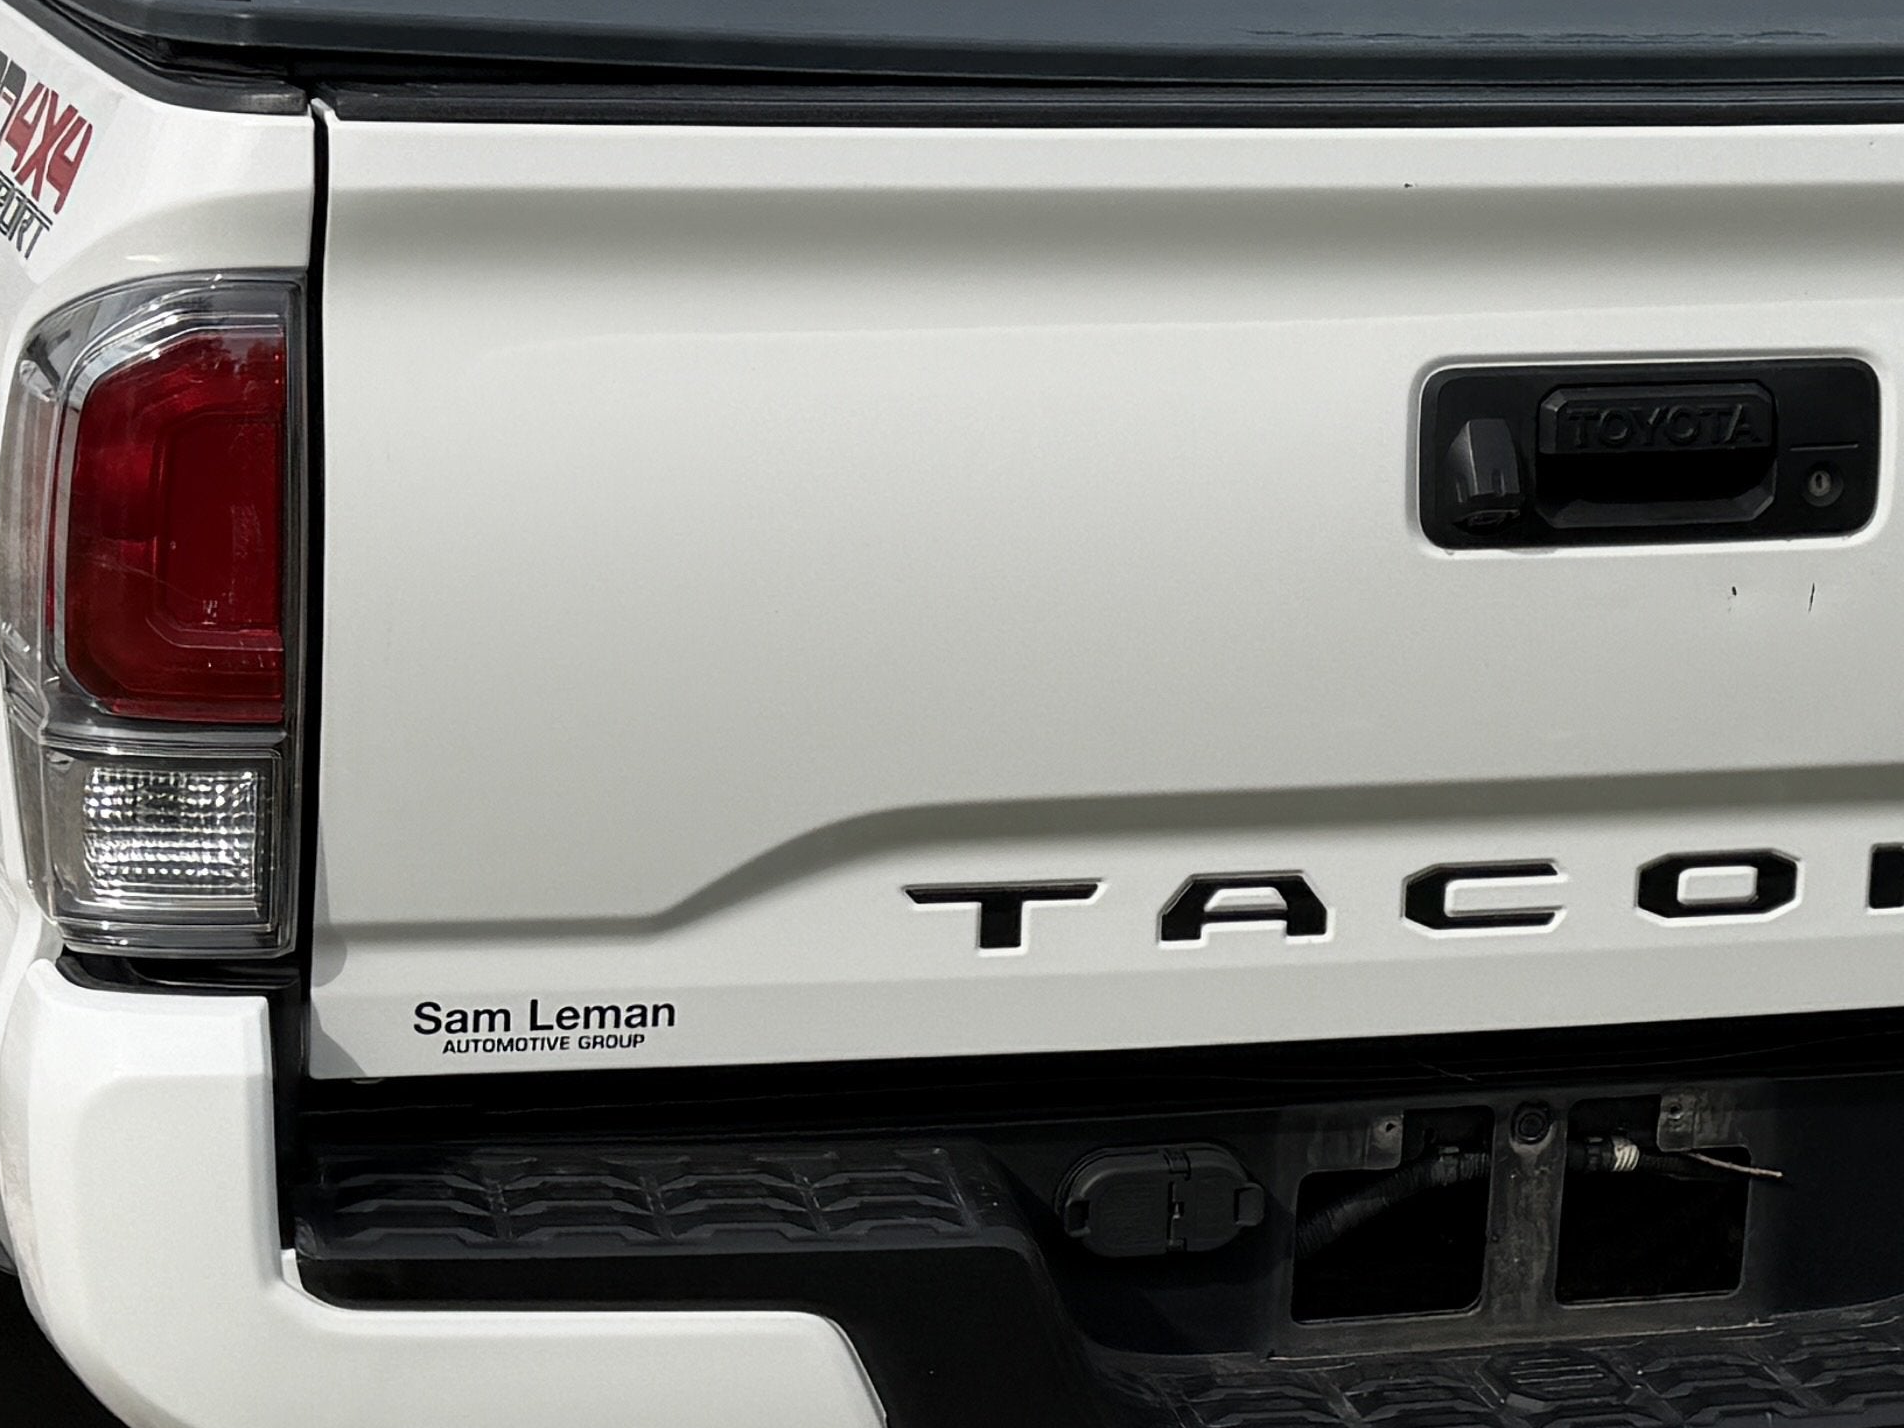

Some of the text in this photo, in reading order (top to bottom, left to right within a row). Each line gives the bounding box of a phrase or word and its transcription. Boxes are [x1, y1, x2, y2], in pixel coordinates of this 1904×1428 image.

[1566, 404, 1764, 450] TOYOTA
[413, 998, 676, 1035] Sam Leman
[442, 1034, 645, 1054] AUTOMOTIVE GROUP
